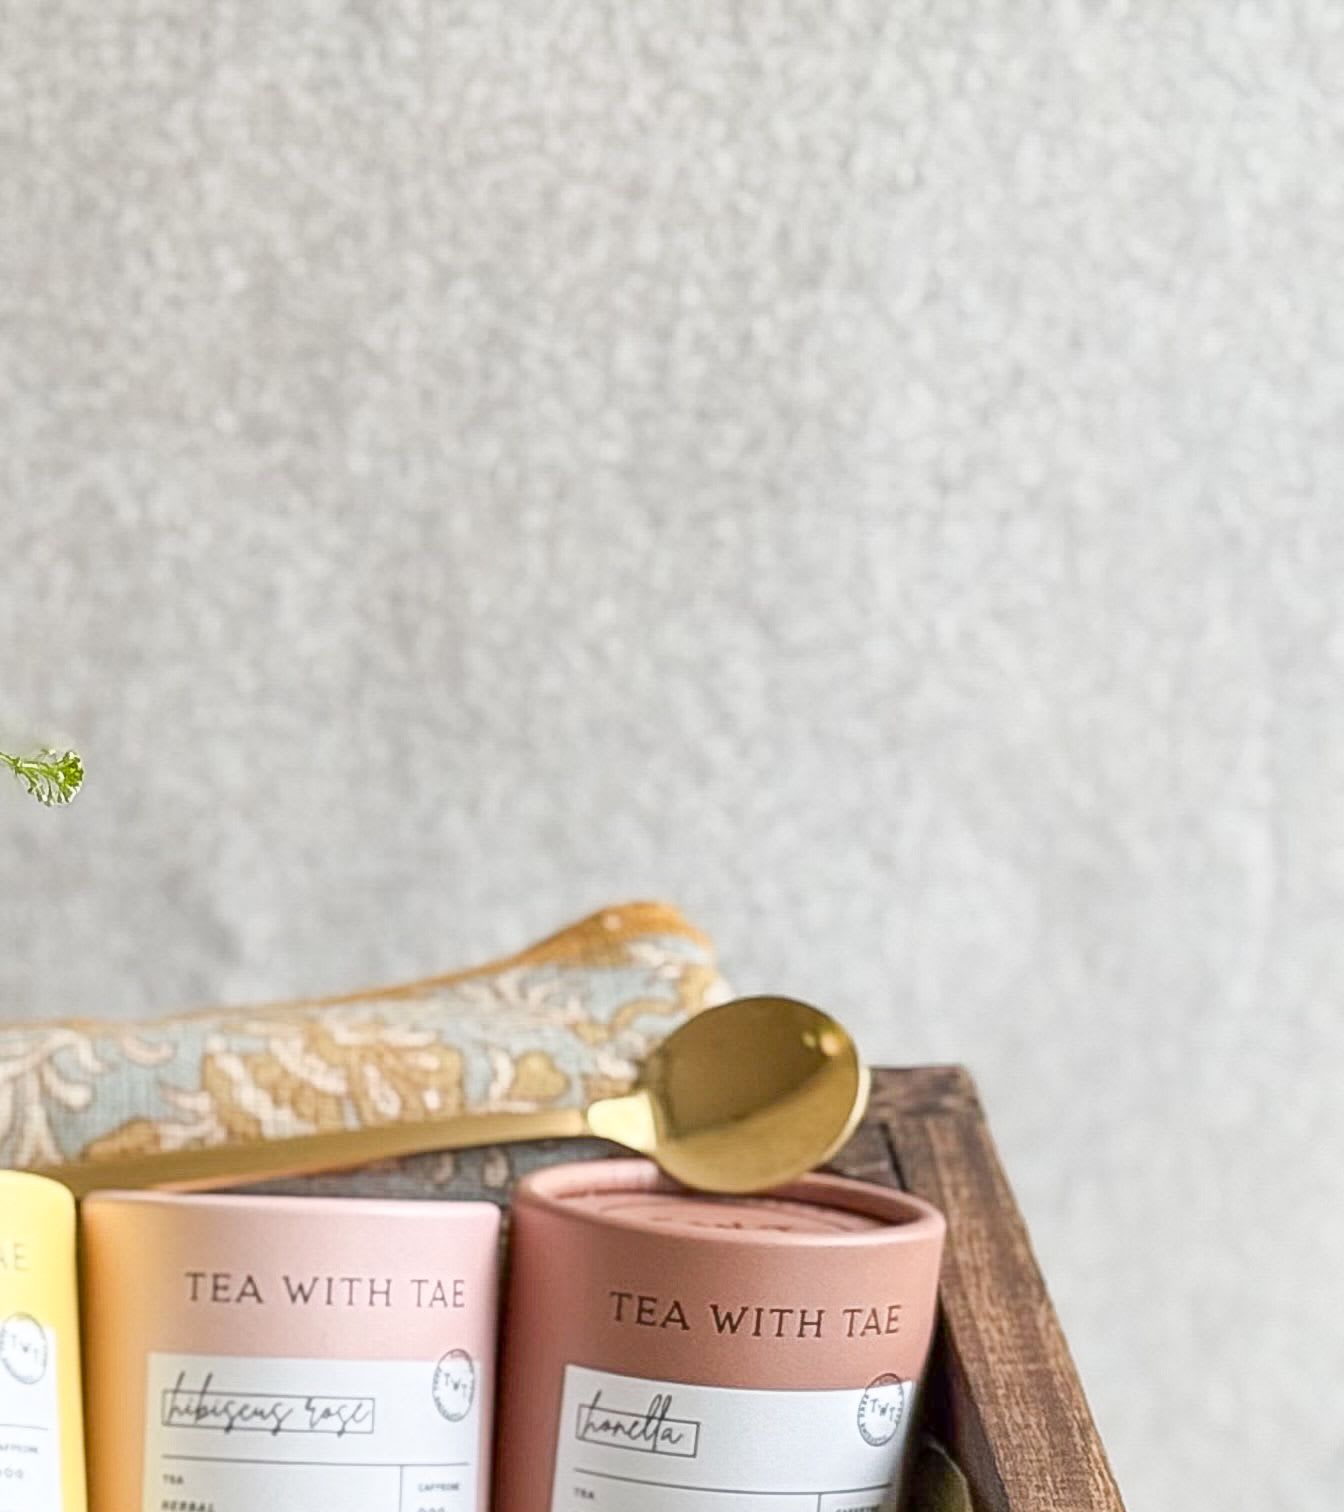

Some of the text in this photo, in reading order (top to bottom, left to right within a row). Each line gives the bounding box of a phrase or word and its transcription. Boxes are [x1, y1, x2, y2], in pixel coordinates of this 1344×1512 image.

[185, 1272, 465, 1308] TEA WITH TAE
[610, 1291, 902, 1338] TEA WITH TAE
[167, 1371, 370, 1436] hibiscus rose
